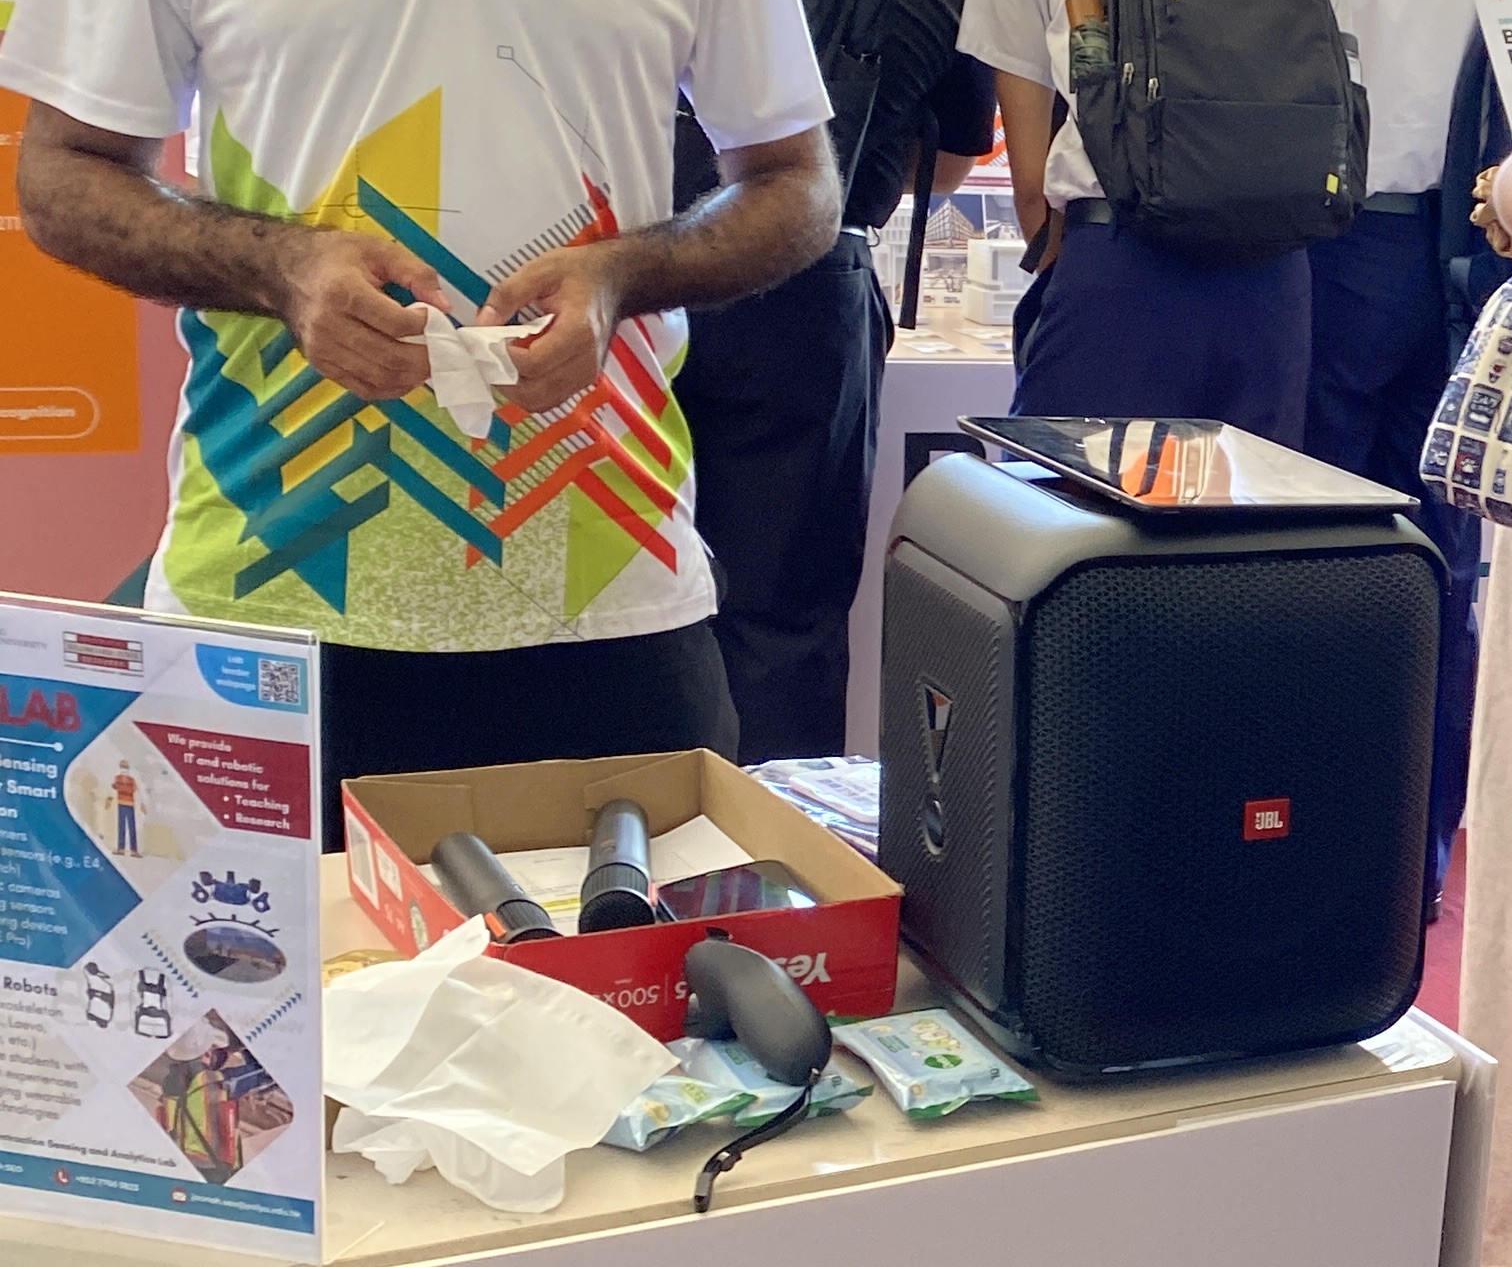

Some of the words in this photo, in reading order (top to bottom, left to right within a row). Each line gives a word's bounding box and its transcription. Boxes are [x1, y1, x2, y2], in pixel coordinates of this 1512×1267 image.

[167, 732, 187, 745] We
[188, 738, 232, 752] provide
[0, 754, 58, 779] ensing
[196, 756, 220, 768] and
[221, 759, 264, 774] robotic
[6, 778, 57, 799] Smart
[197, 773, 249, 789] solutions
[252, 778, 270, 792] for
[234, 794, 290, 815] Teaching
[235, 812, 290, 830] Research
[1254, 811, 1284, 830] JBL
[3, 976, 58, 997] Robots
